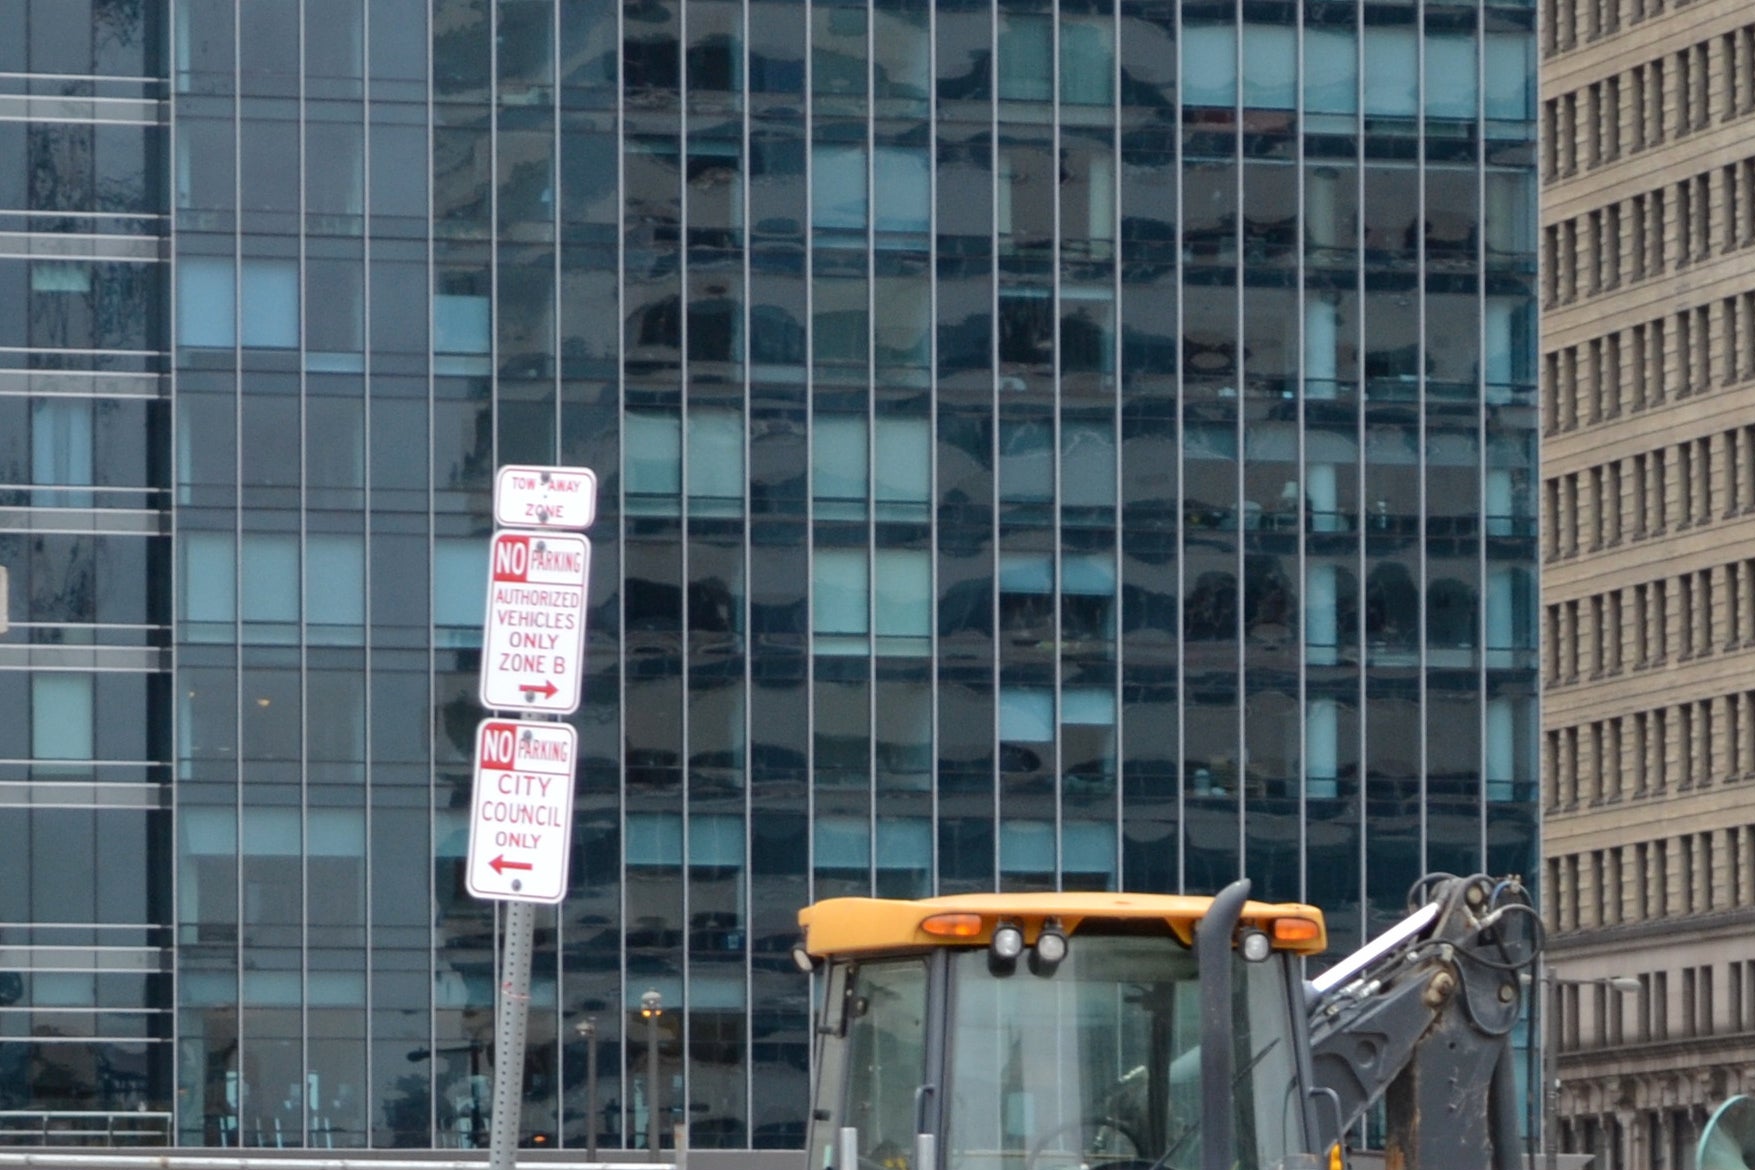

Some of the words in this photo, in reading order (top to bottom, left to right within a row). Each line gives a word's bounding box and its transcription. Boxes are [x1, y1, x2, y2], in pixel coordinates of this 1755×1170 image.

[512, 476, 536, 490] TOW
[547, 479, 581, 492] AWAY
[525, 503, 564, 518] ZONE
[496, 541, 527, 576] NO
[531, 549, 581, 573] PARKING
[496, 588, 580, 608] AUTHORIZED
[498, 610, 574, 629] VEHICLES
[509, 631, 558, 649] ONLY
[498, 653, 546, 673] ZONE
[553, 656, 566, 674] B
[483, 729, 514, 763] NO
[518, 738, 568, 762] PARKING
[498, 773, 552, 797] CITY
[482, 800, 561, 827] COUNCIL
[495, 831, 541, 849] ONLY
